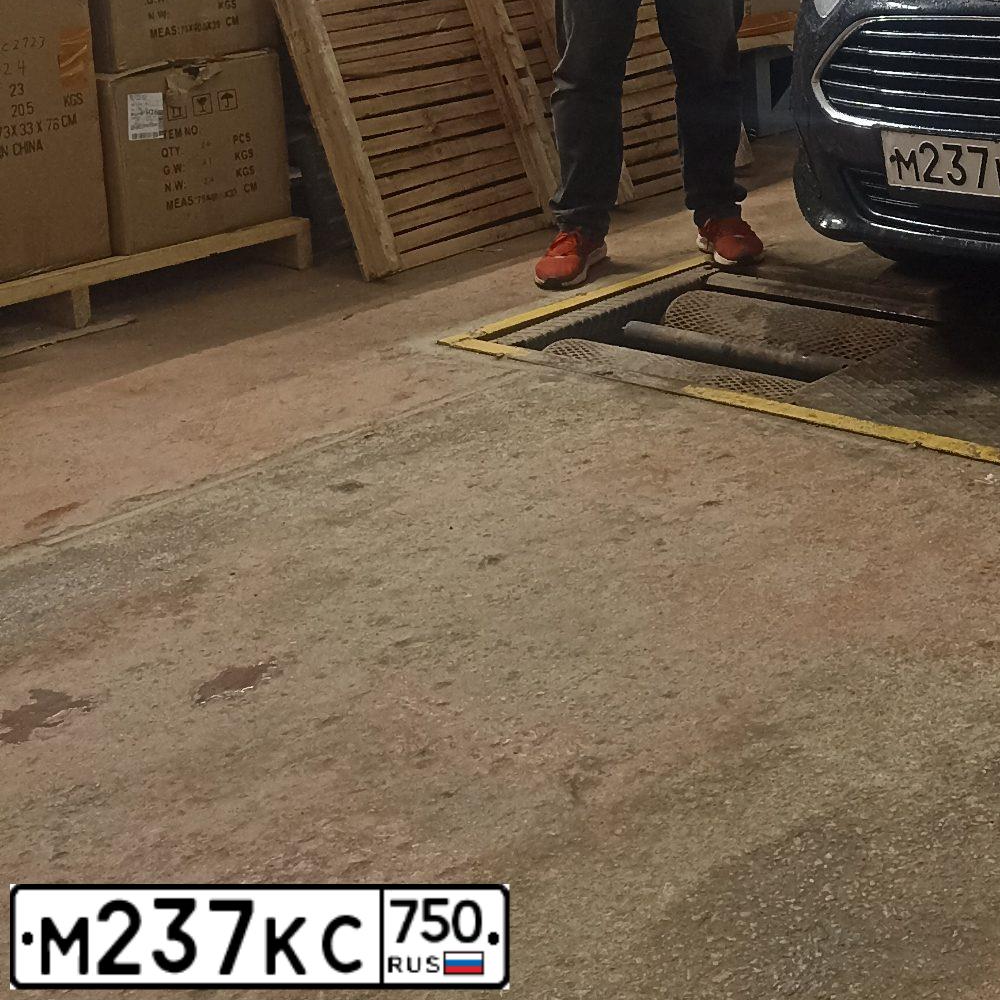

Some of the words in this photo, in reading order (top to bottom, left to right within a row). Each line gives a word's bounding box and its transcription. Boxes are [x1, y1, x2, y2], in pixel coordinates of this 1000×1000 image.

[218, 0, 237, 11] KGS
[225, 15, 240, 27] CM
[9, 82, 25, 98] 23
[63, 92, 84, 108] KGS
[232, 132, 252, 145] PCS
[12, 139, 44, 157] CHINA
[234, 148, 254, 161] KGS
[236, 165, 256, 178] KGS
[243, 181, 258, 193] CM
